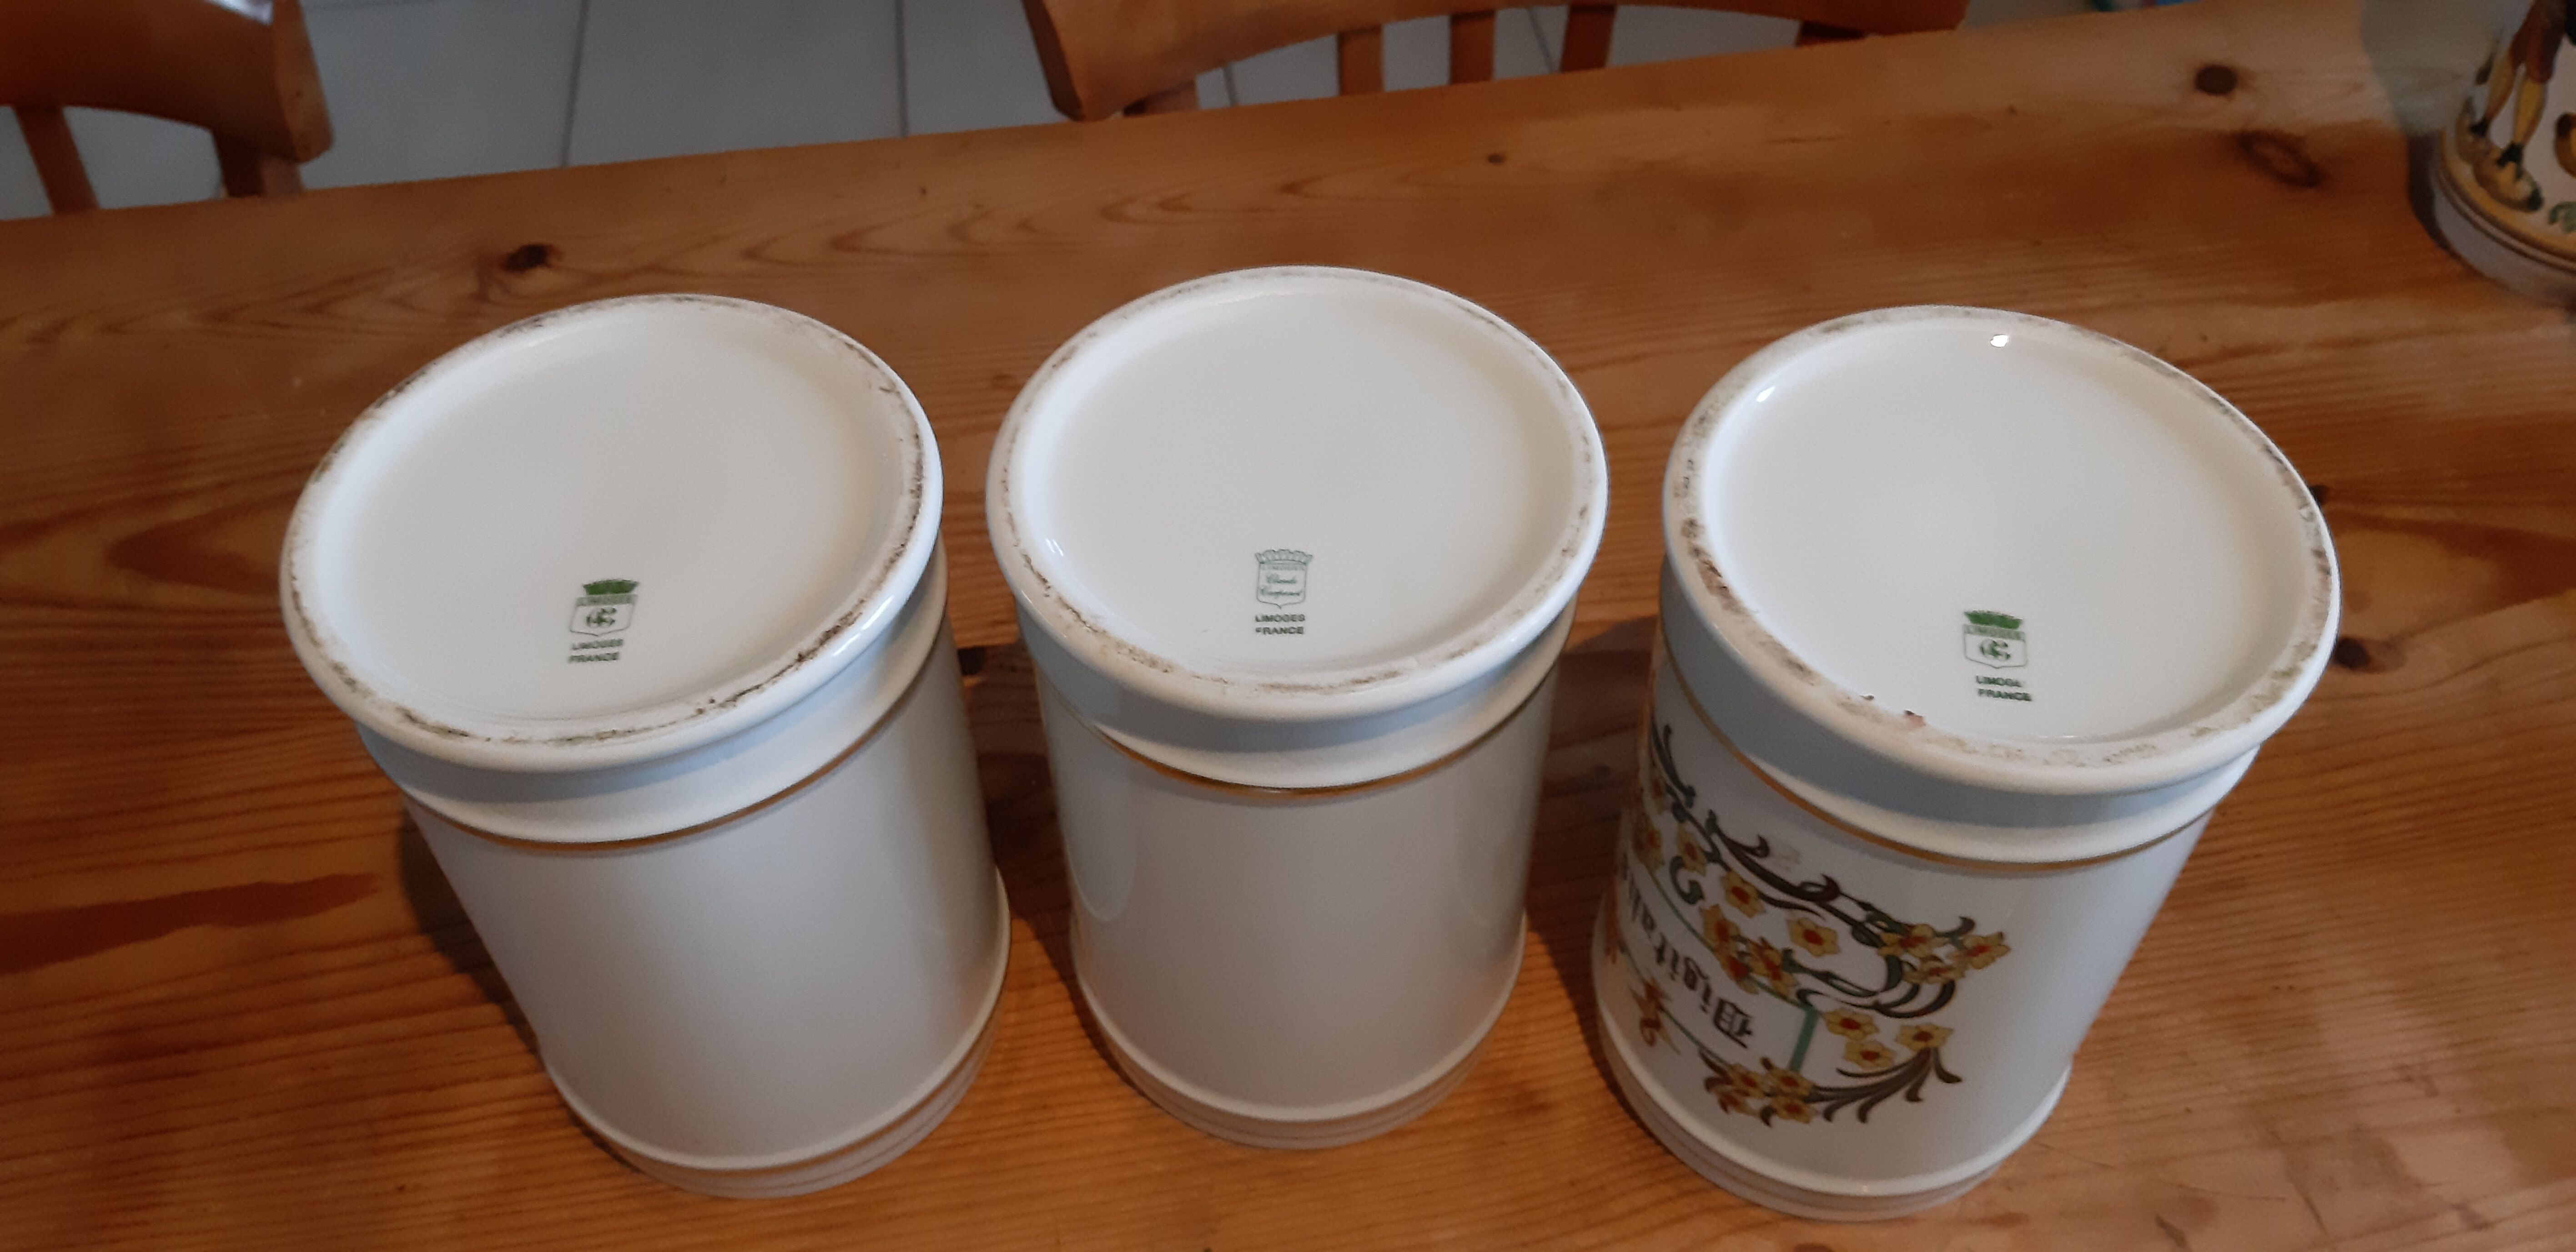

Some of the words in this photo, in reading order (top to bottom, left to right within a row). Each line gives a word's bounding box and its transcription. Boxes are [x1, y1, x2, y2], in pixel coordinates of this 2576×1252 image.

[1255, 626, 1304, 635] FRANCE
[569, 651, 619, 663] FRANCE
[1978, 688, 2032, 702] FRANCE
